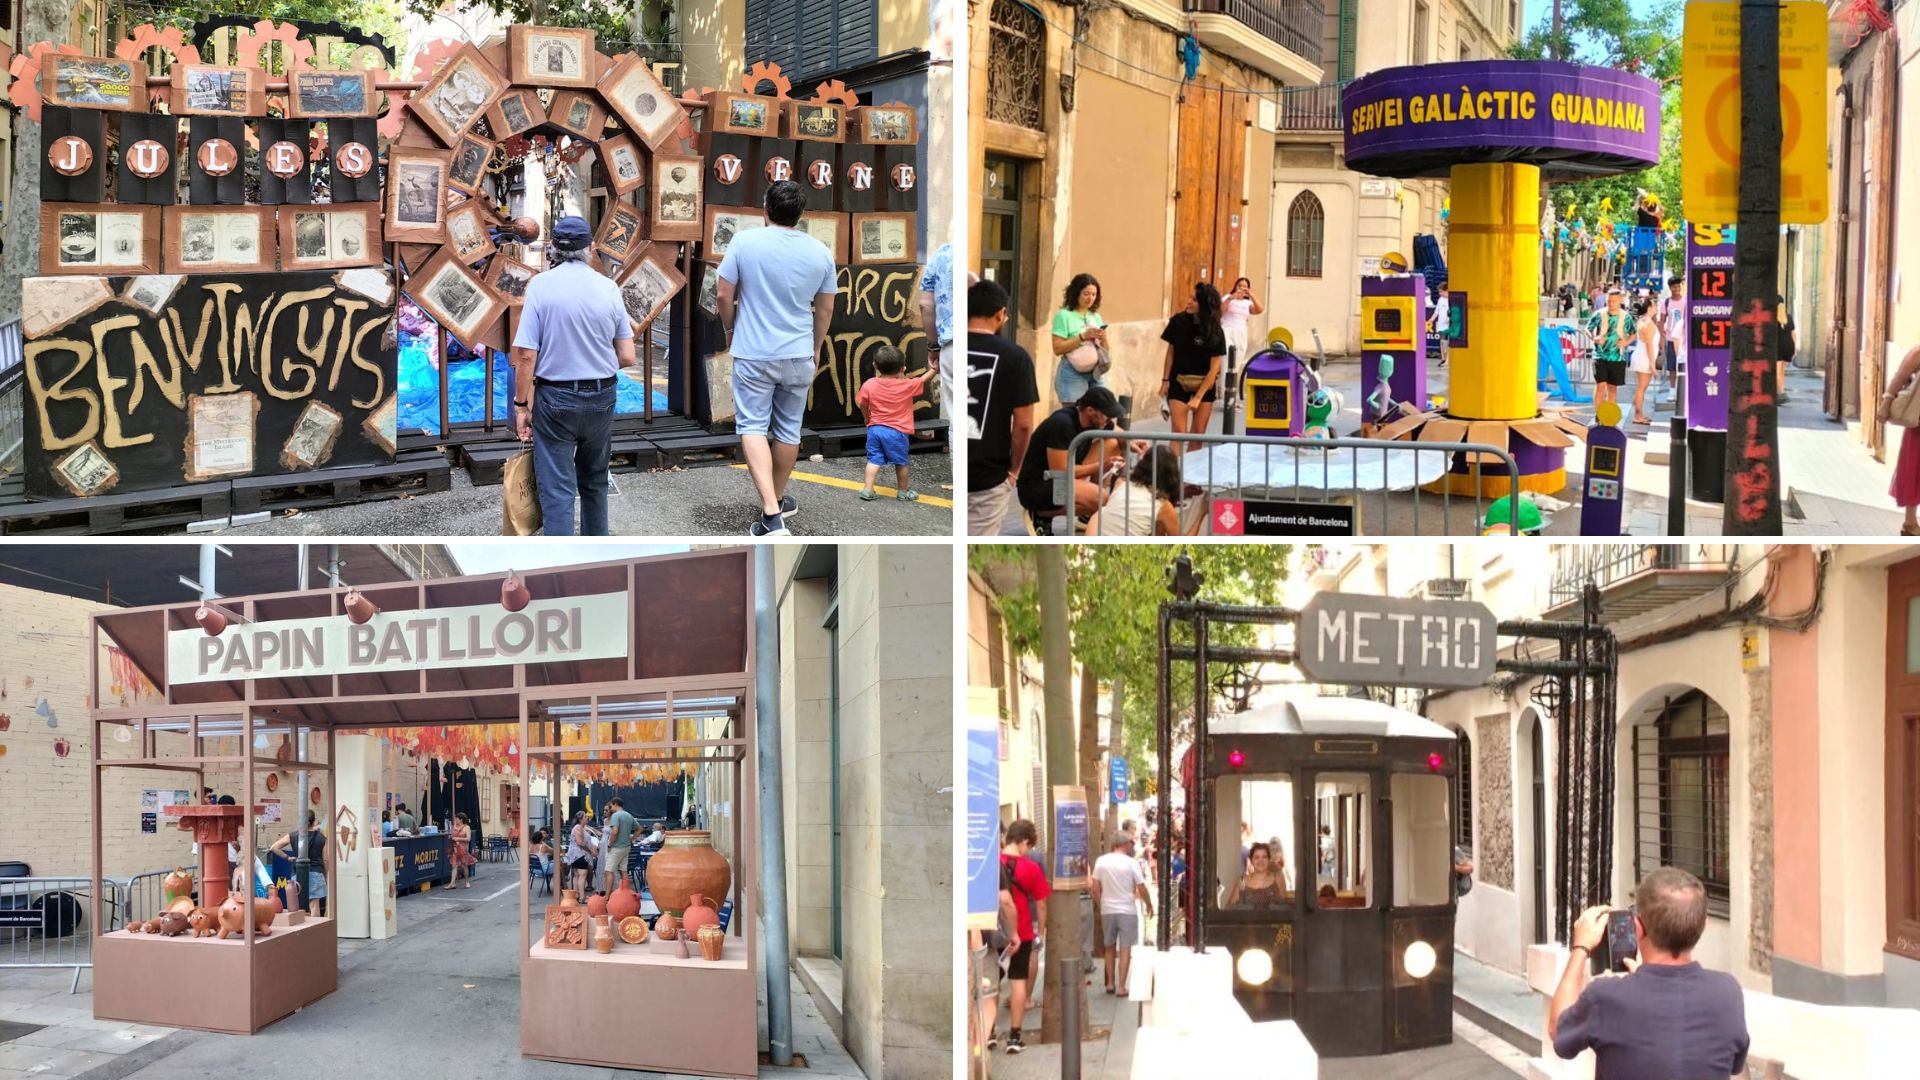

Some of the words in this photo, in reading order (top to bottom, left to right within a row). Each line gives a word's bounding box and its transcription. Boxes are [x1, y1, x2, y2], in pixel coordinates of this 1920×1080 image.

[99, 83, 130, 91] 20000
[1352, 98, 1403, 134] SERVEI
[1410, 85, 1536, 123] GALÀCTIC
[1551, 92, 1645, 133] GUADIANA
[59, 140, 366, 174] JULES
[721, 157, 914, 190] VERNE
[989, 172, 997, 188] 9
[836, 266, 913, 323] ARG
[1702, 271, 1735, 297] 1.2
[1692, 305, 1733, 315] GUADIAN
[23, 282, 393, 450] BENVINGUTS
[1249, 513, 1297, 525] Ajuntament
[1297, 515, 1308, 525] de
[1308, 516, 1349, 528] Barcelona
[198, 626, 324, 675] PAPIN
[348, 606, 583, 667] BATLLORI
[1317, 608, 1480, 670] METRO
[414, 848, 439, 865] MORITZ
